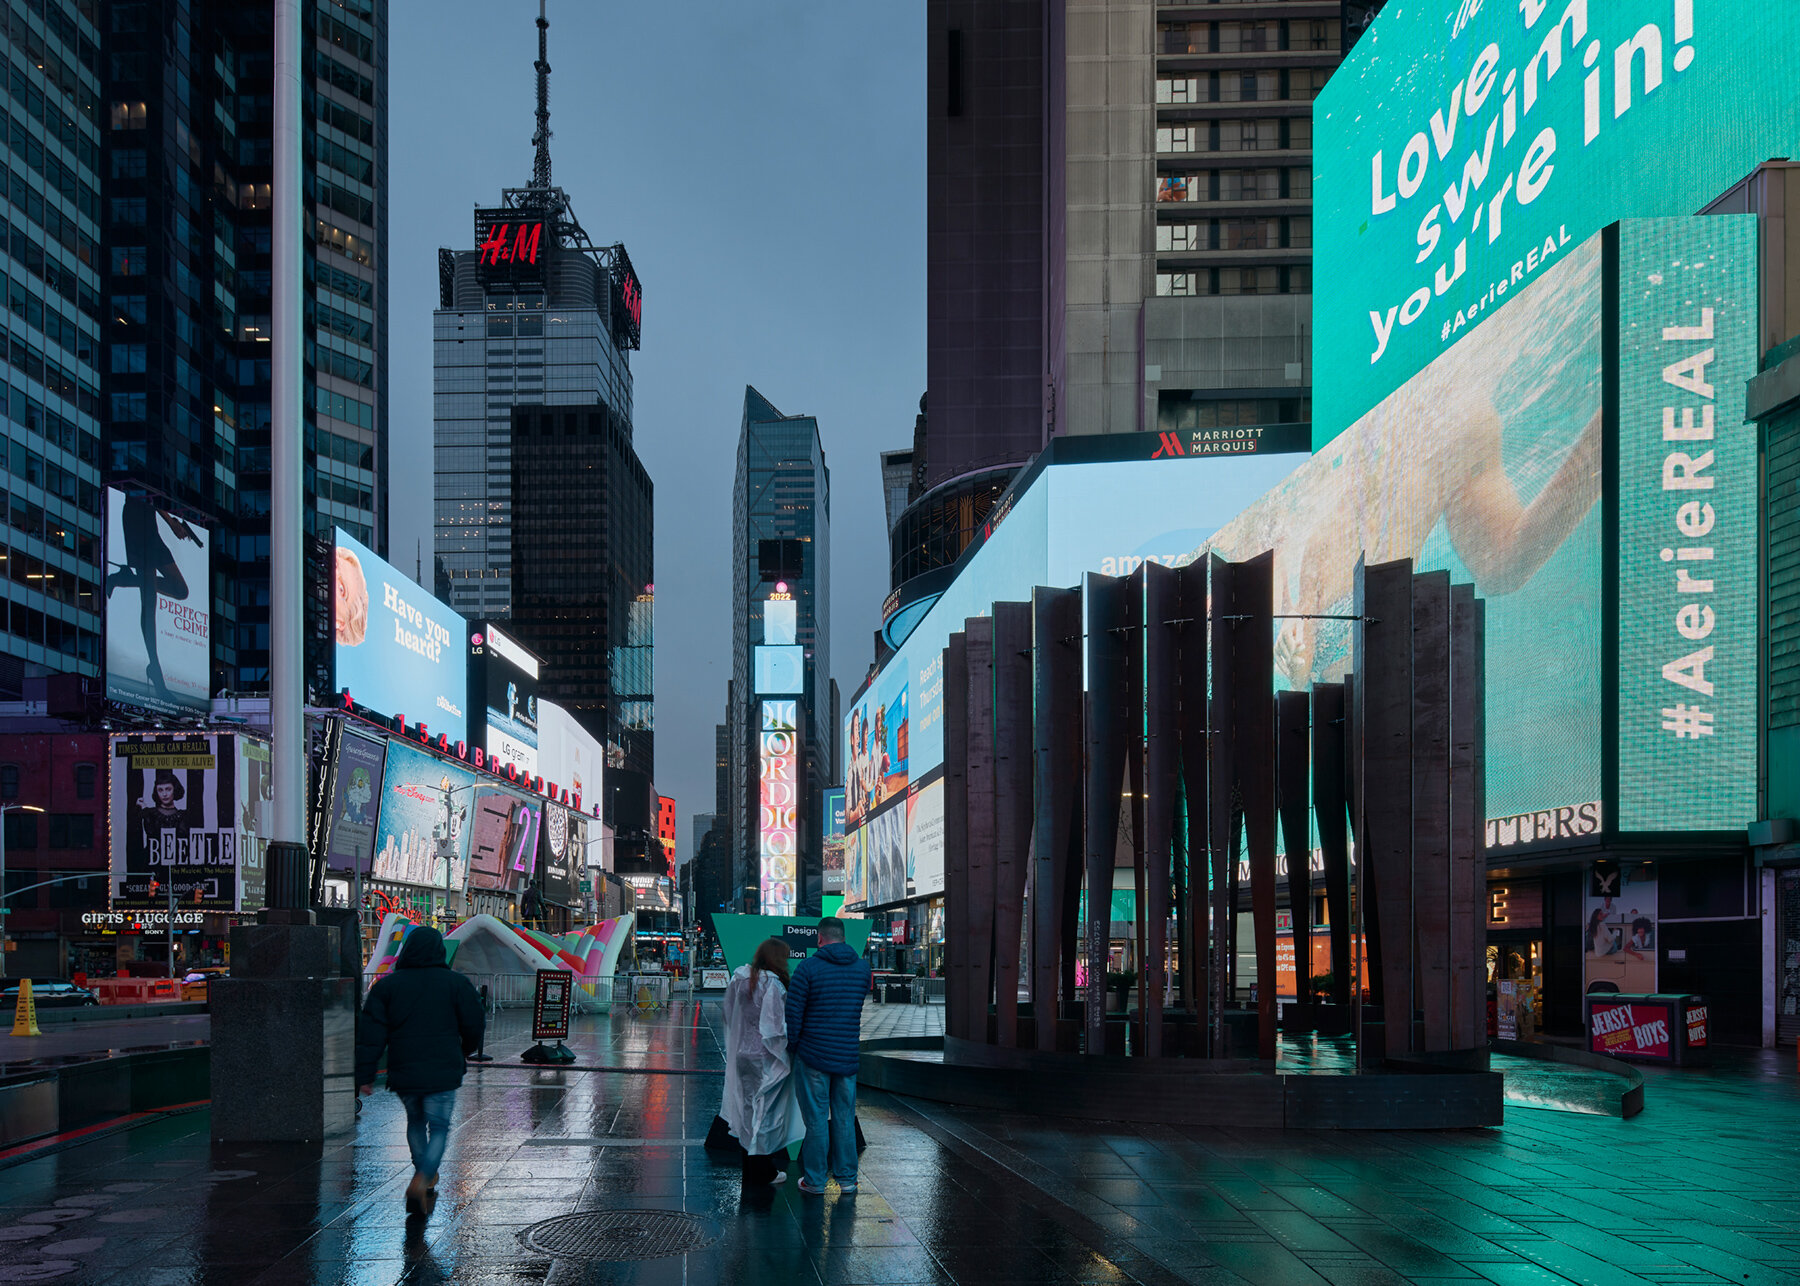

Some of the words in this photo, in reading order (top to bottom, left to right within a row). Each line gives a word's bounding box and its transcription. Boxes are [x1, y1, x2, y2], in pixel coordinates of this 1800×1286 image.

[1372, 43, 1500, 216] Love
[1416, 0, 1588, 264] swim
[1369, 127, 1557, 365] you're
[1584, 0, 1695, 147] in!
[480, 222, 542, 266] H&M
[623, 272, 642, 326] H&M
[1441, 224, 1572, 342] #AerieREAL
[1192, 428, 1264, 441] MARRIOTT
[1192, 442, 1256, 454] MARQUIS
[1660, 308, 1714, 739] #AerieREAL
[160, 598, 208, 625] PERFECT
[174, 617, 208, 638] CRIME
[384, 582, 422, 628] Have
[425, 616, 450, 647] you
[394, 618, 440, 664] heard?
[118, 744, 138, 754] TIMES
[139, 743, 166, 754] SQUARE
[167, 742, 180, 752] CAN
[182, 742, 208, 752] REALLY
[135, 758, 154, 766] MAKE
[156, 757, 170, 766] YOU
[172, 756, 188, 766] FEEL
[473, 747, 580, 811] BROADWAY
[148, 832, 234, 866] BEETLE
[81, 912, 124, 924] GIFTS
[787, 926, 818, 936] Design
[1592, 1004, 1634, 1036] JERSEY
[1686, 1006, 1708, 1024] JERSEY
[1632, 1020, 1670, 1050] BOYS
[1688, 1026, 1706, 1042] BOYS
